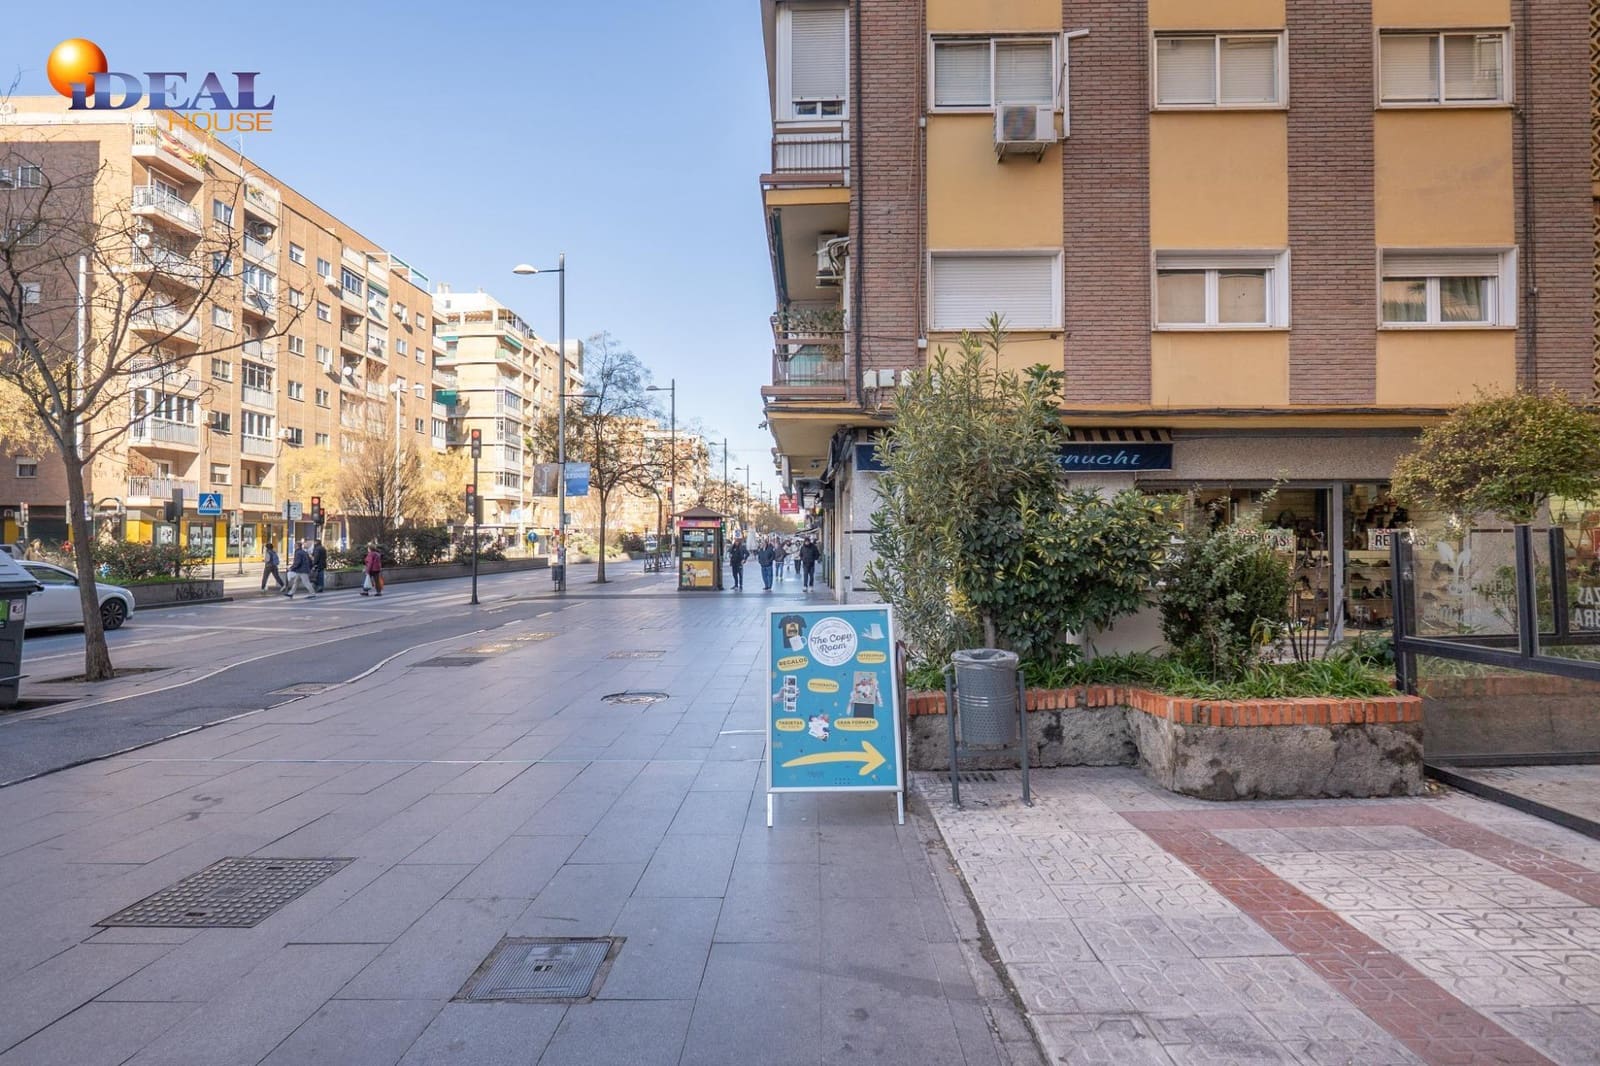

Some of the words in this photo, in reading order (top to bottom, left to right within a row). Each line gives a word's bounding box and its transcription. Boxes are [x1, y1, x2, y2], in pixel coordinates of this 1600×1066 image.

[810, 636, 829, 645] The
[829, 633, 852, 643] Copy
[819, 643, 847, 653] Room
[778, 657, 808, 667] REGALOS
